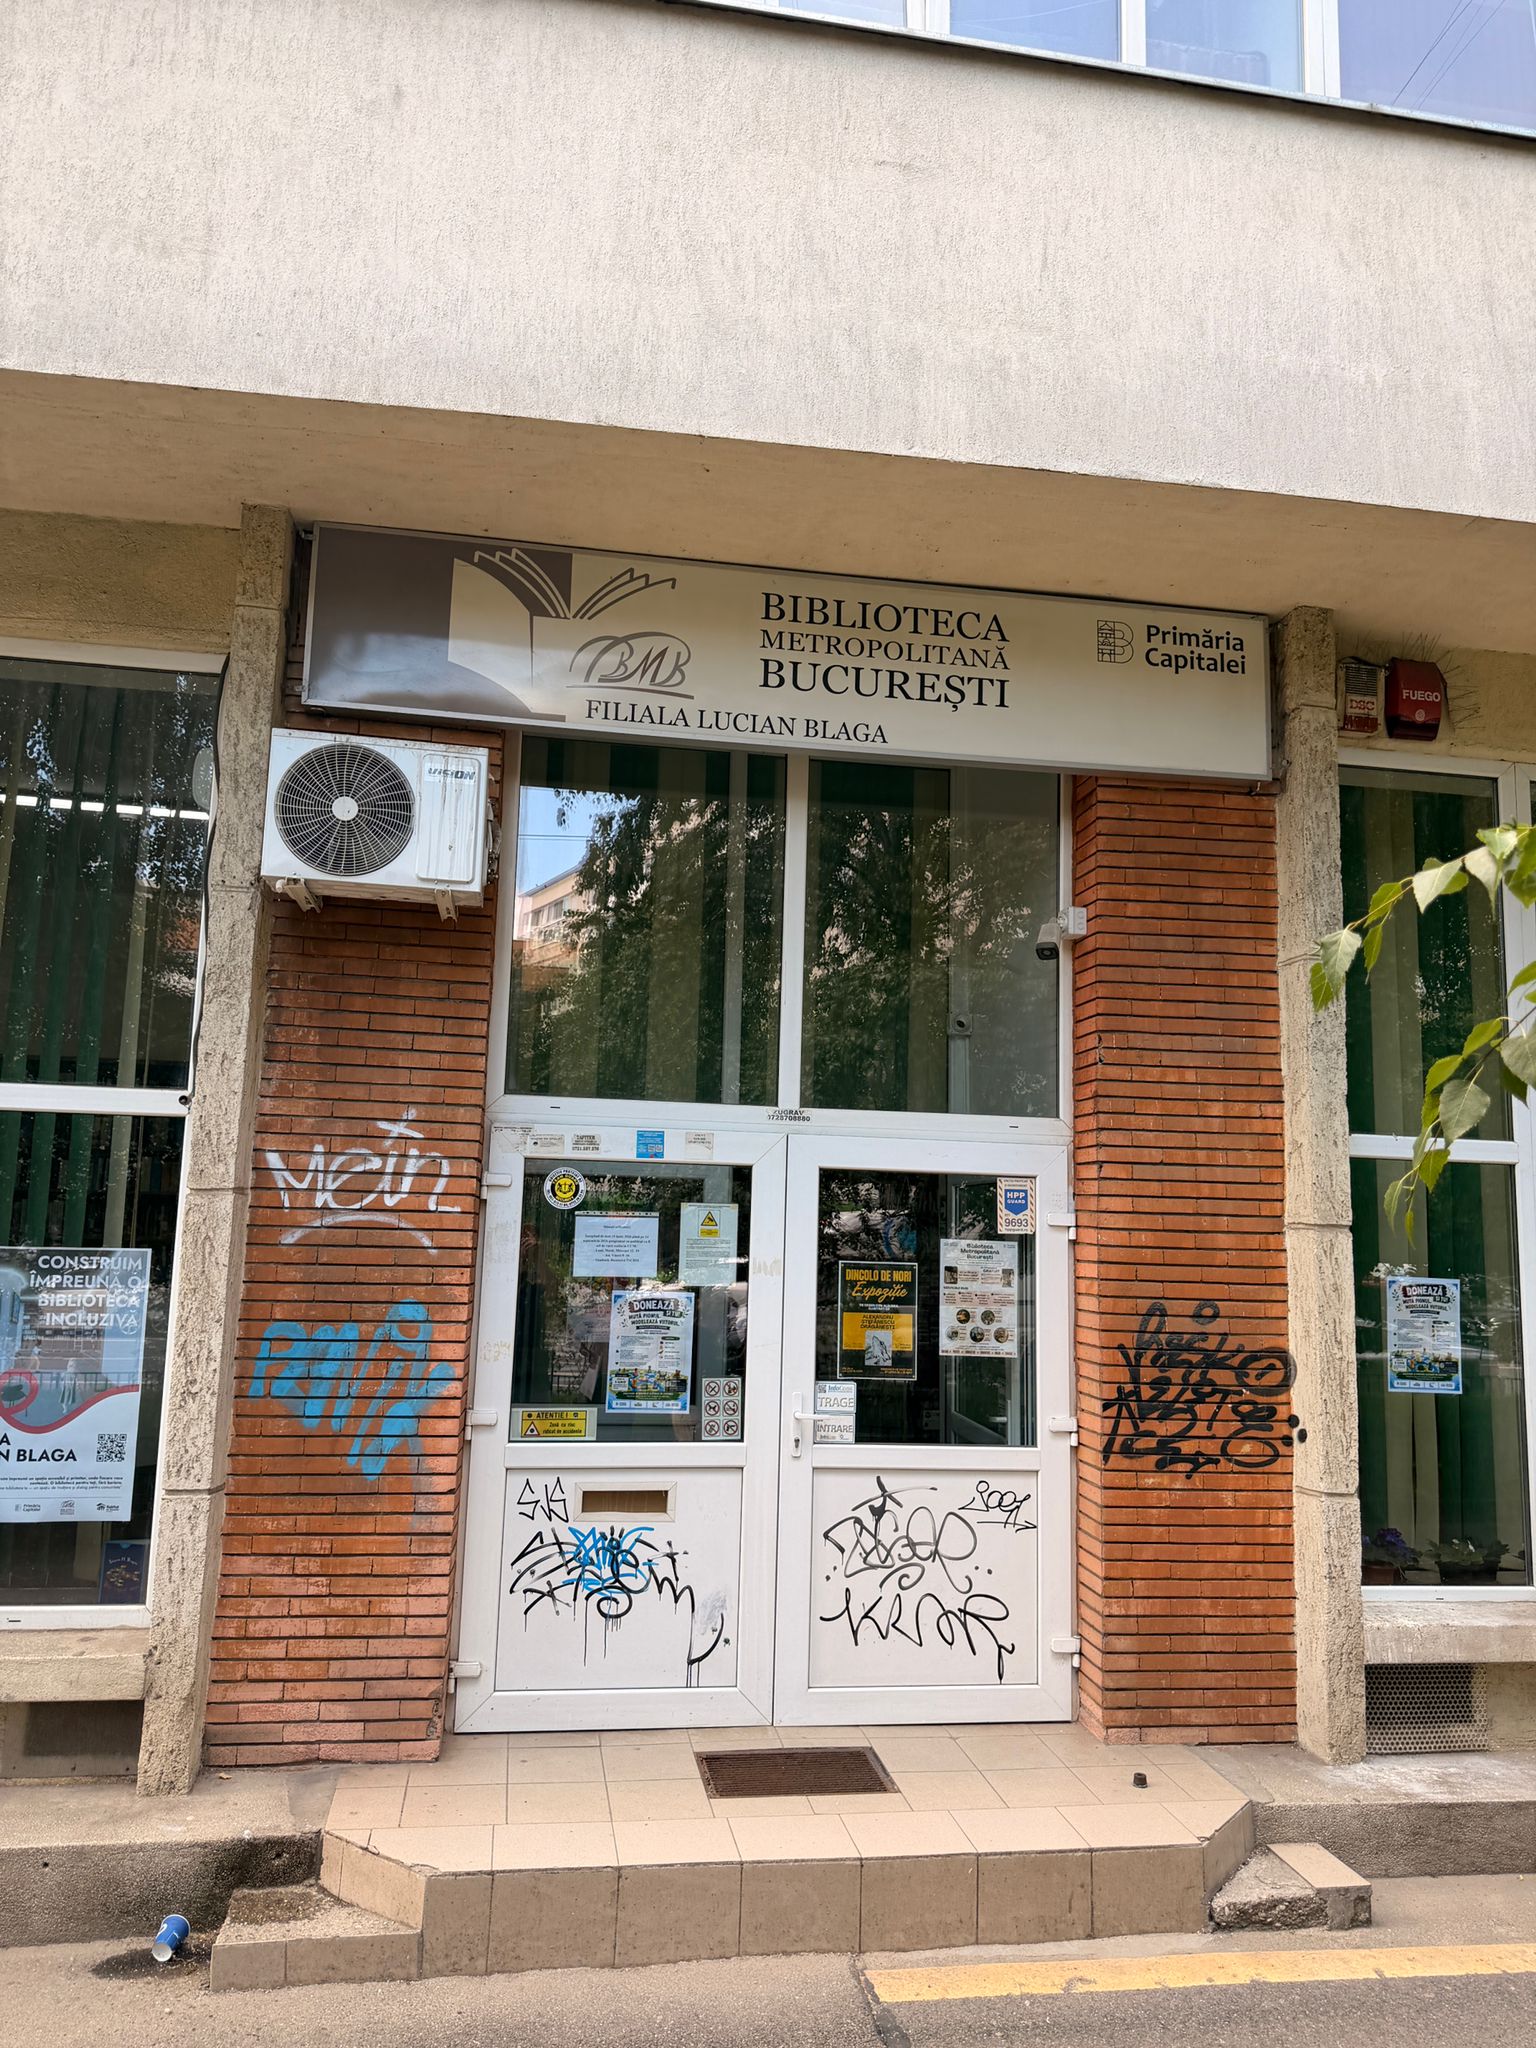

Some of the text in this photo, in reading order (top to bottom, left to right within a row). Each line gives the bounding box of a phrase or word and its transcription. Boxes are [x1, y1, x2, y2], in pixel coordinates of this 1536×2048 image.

[761, 592, 1010, 642] BIBLIOTECA
[1146, 625, 1244, 651] Primăria
[760, 629, 1010, 670] METROPOLITANĂ
[1145, 648, 1246, 674] Capitalei
[759, 658, 1010, 712] BUCUREȘTI
[1402, 690, 1441, 702] FUEGO
[1349, 700, 1375, 711] DSC
[585, 699, 888, 744] FILIALA LUCIAN BLAGA
[1007, 1191, 1026, 1199] HPP
[1004, 1218, 1029, 1227] 9693
[38, 1255, 143, 1270] CONSTRUIM
[29, 1269, 123, 1289] ÎMPREUNĂ
[845, 1268, 912, 1282] DINCOLO DE NORI
[1405, 1285, 1443, 1295] DONEAZĂ
[633, 1298, 675, 1310] DONEAZĂ
[46, 1310, 138, 1326] INCLUZIVĂ
[818, 1396, 854, 1407] TRAGE
[817, 1424, 854, 1432] INTRARE
[16, 1448, 78, 1462] BLAGA
